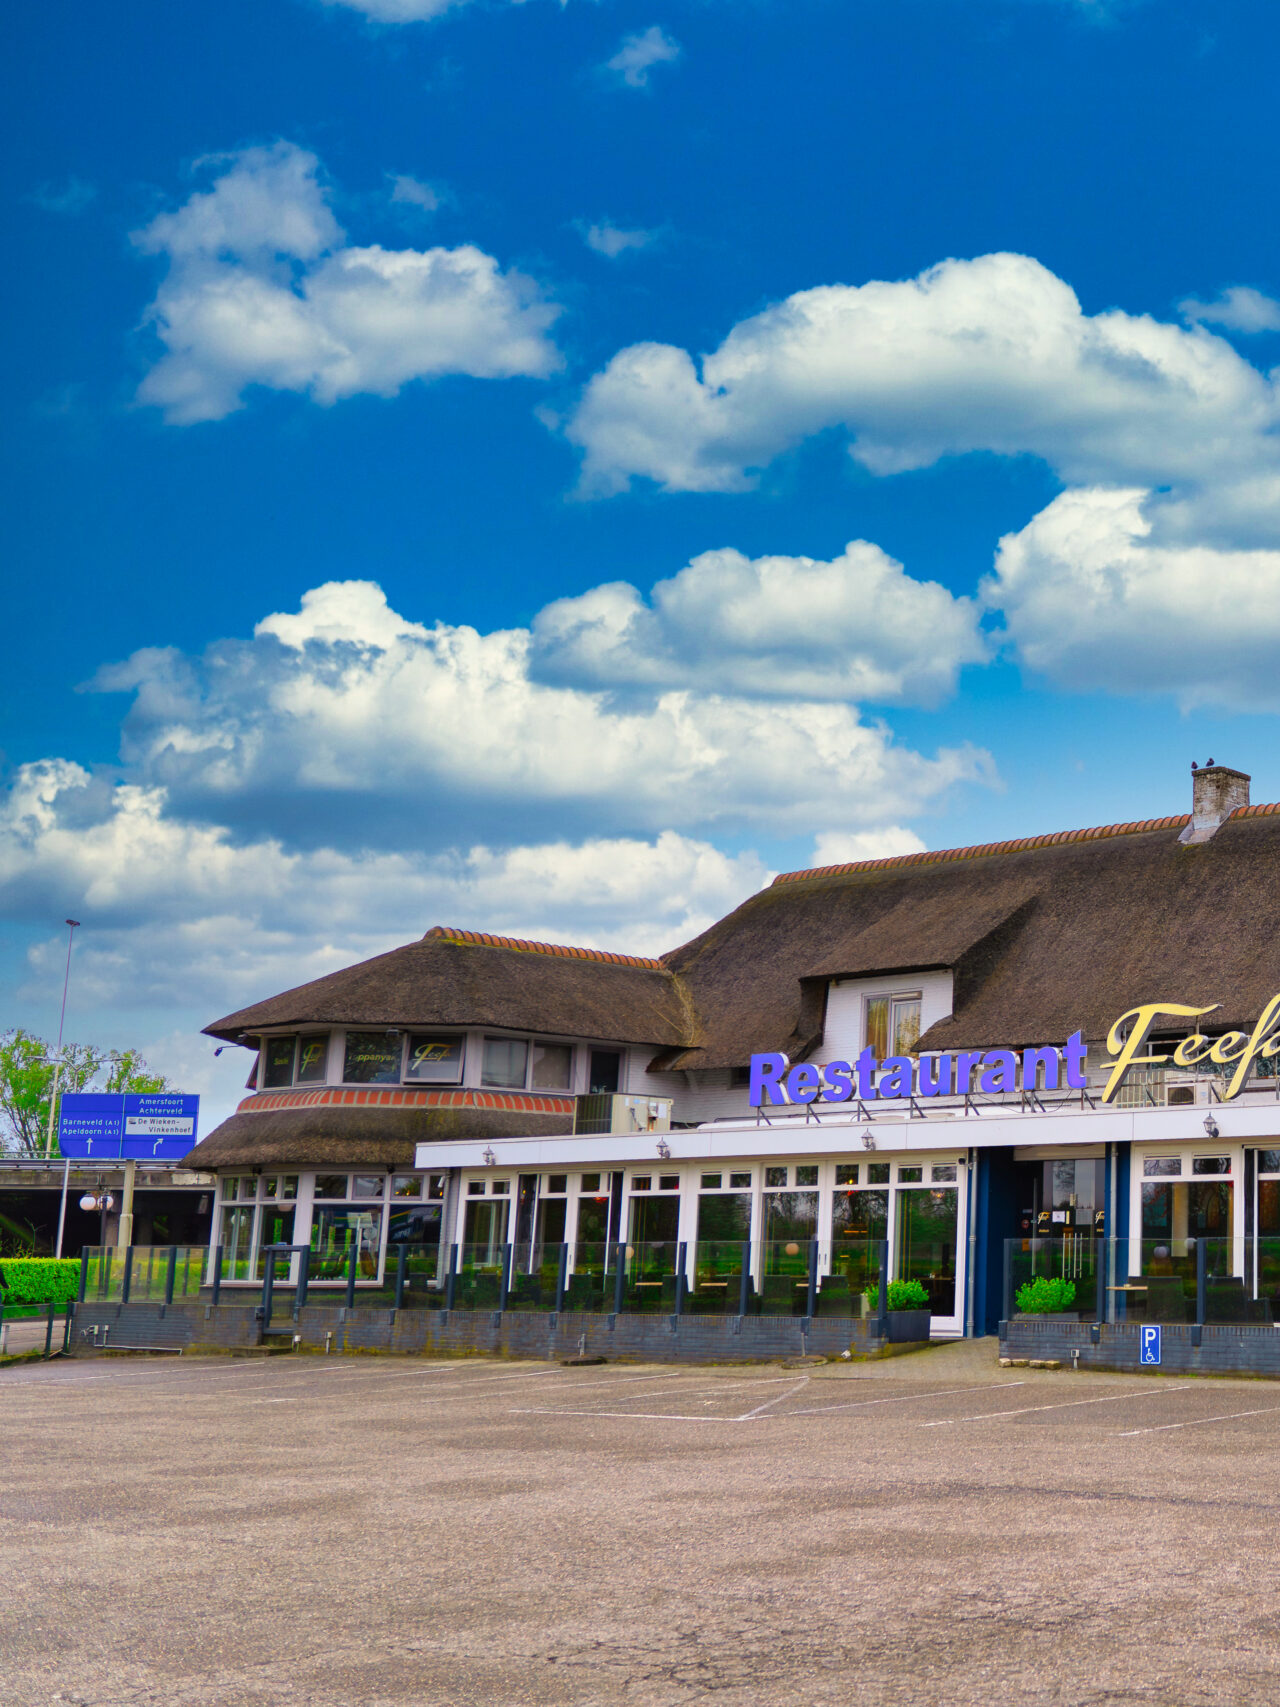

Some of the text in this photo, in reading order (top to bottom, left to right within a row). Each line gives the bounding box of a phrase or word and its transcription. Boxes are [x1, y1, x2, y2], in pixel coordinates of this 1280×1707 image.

[748, 1029, 1088, 1107] Restaurant
[138, 1098, 184, 1106] Amersfoort
[138, 1107, 183, 1115] Achterveld
[62, 1118, 103, 1126] Barneveld
[62, 1128, 102, 1136] Apeldoorn
[1144, 1328, 1157, 1348] P
